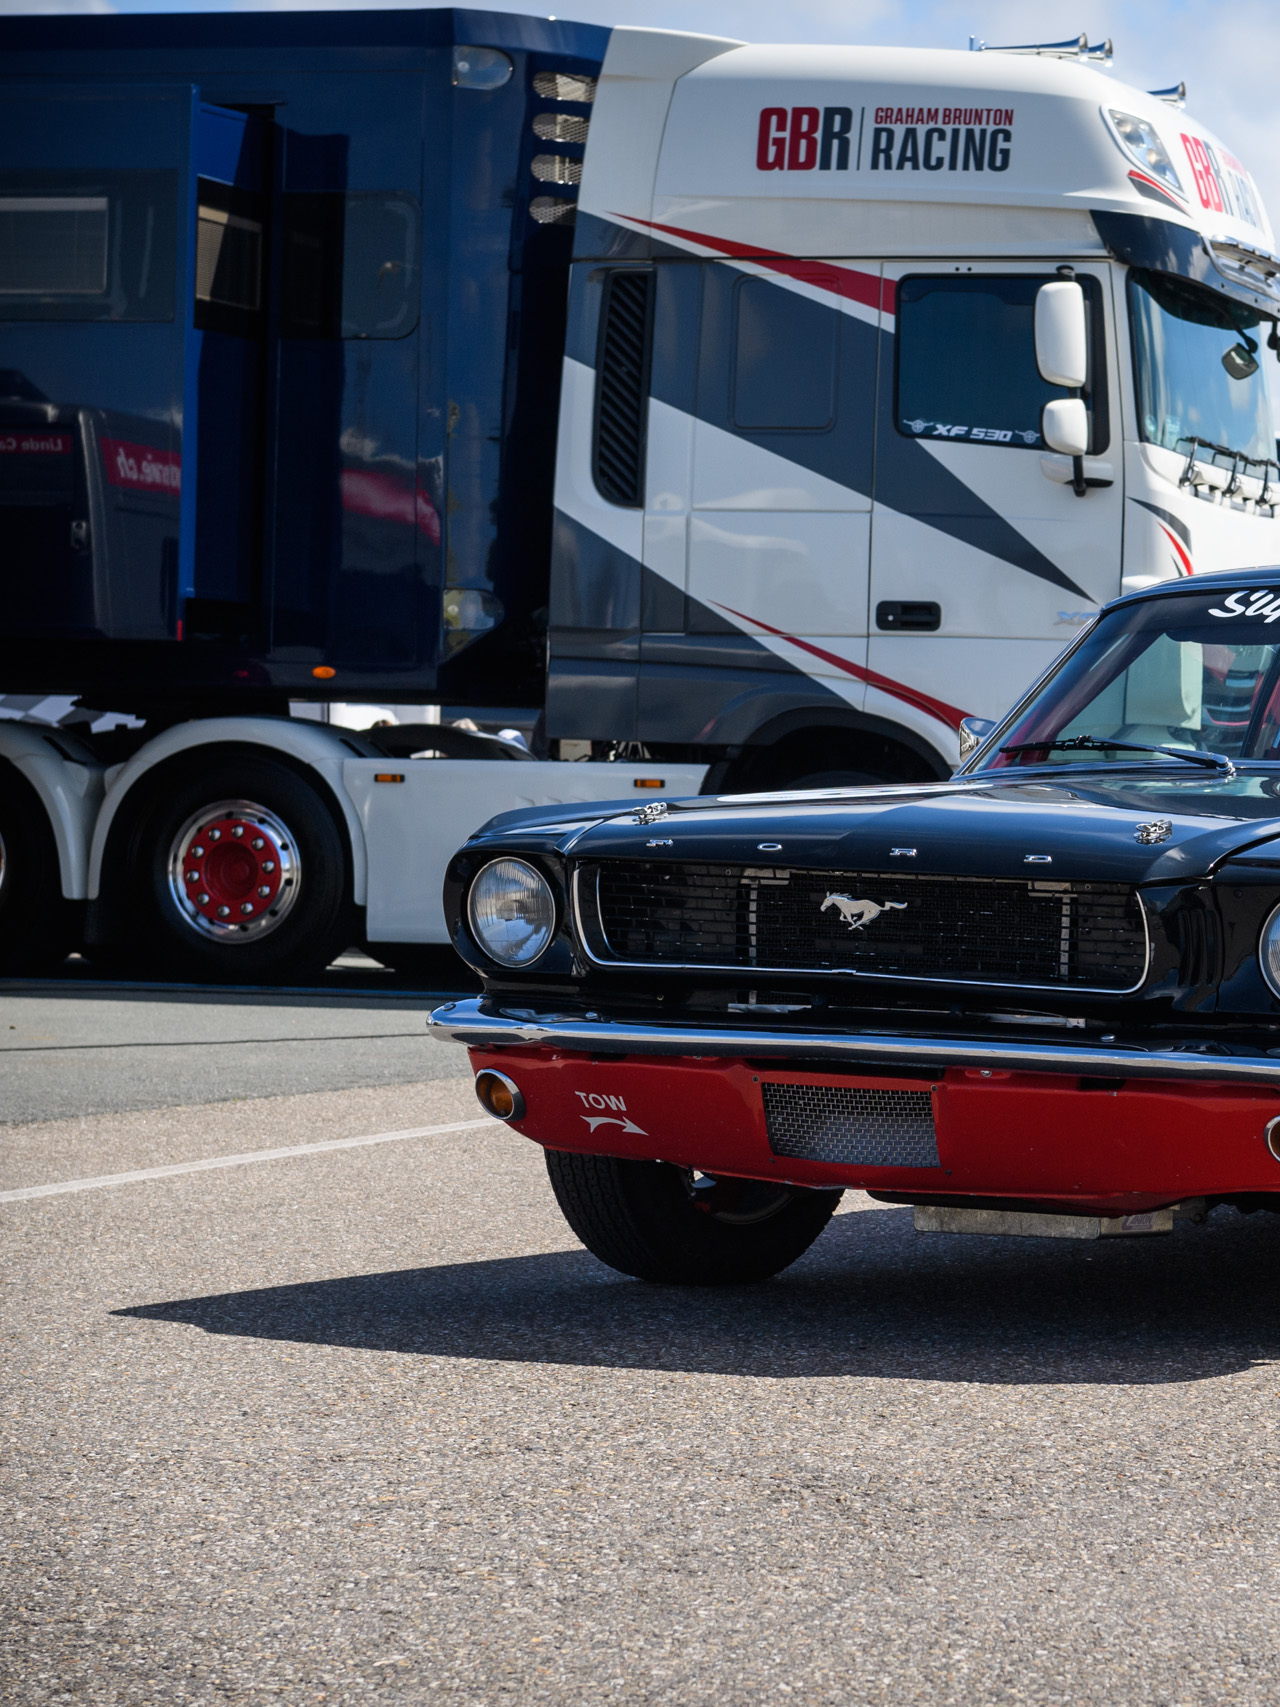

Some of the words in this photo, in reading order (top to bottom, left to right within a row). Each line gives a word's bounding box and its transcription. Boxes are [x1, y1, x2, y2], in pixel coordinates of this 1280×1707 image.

[874, 106, 939, 126] GRAHAM
[942, 108, 1014, 126] BRUNTON
[756, 106, 853, 171] GBR
[870, 127, 1012, 172] RACING
[1180, 132, 1234, 217] GBR
[932, 424, 968, 436] XF
[970, 427, 1013, 442] 530
[574, 1091, 627, 1111] TOW
